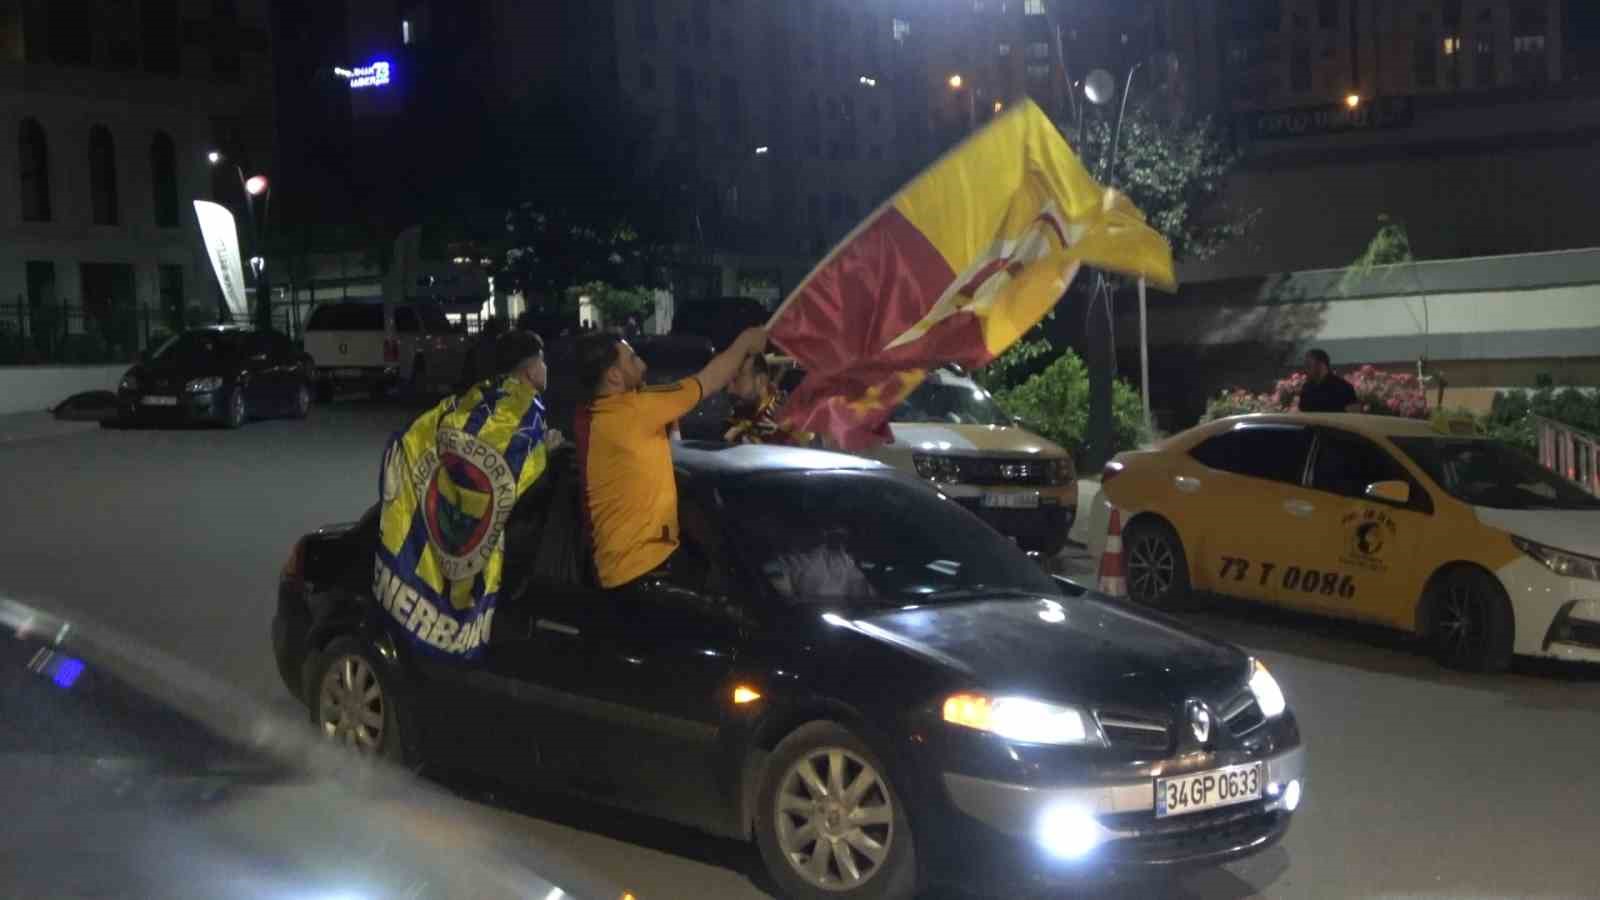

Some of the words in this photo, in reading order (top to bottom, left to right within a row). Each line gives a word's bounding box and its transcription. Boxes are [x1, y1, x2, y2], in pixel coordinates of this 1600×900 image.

[463, 441, 506, 478] SPOR
[1218, 556, 1250, 582] 73
[1258, 562, 1276, 585] T
[1282, 565, 1356, 600] 0086
[1167, 780, 1188, 810] 34
[1190, 776, 1216, 804] GP
[1218, 768, 1258, 799] 0633
